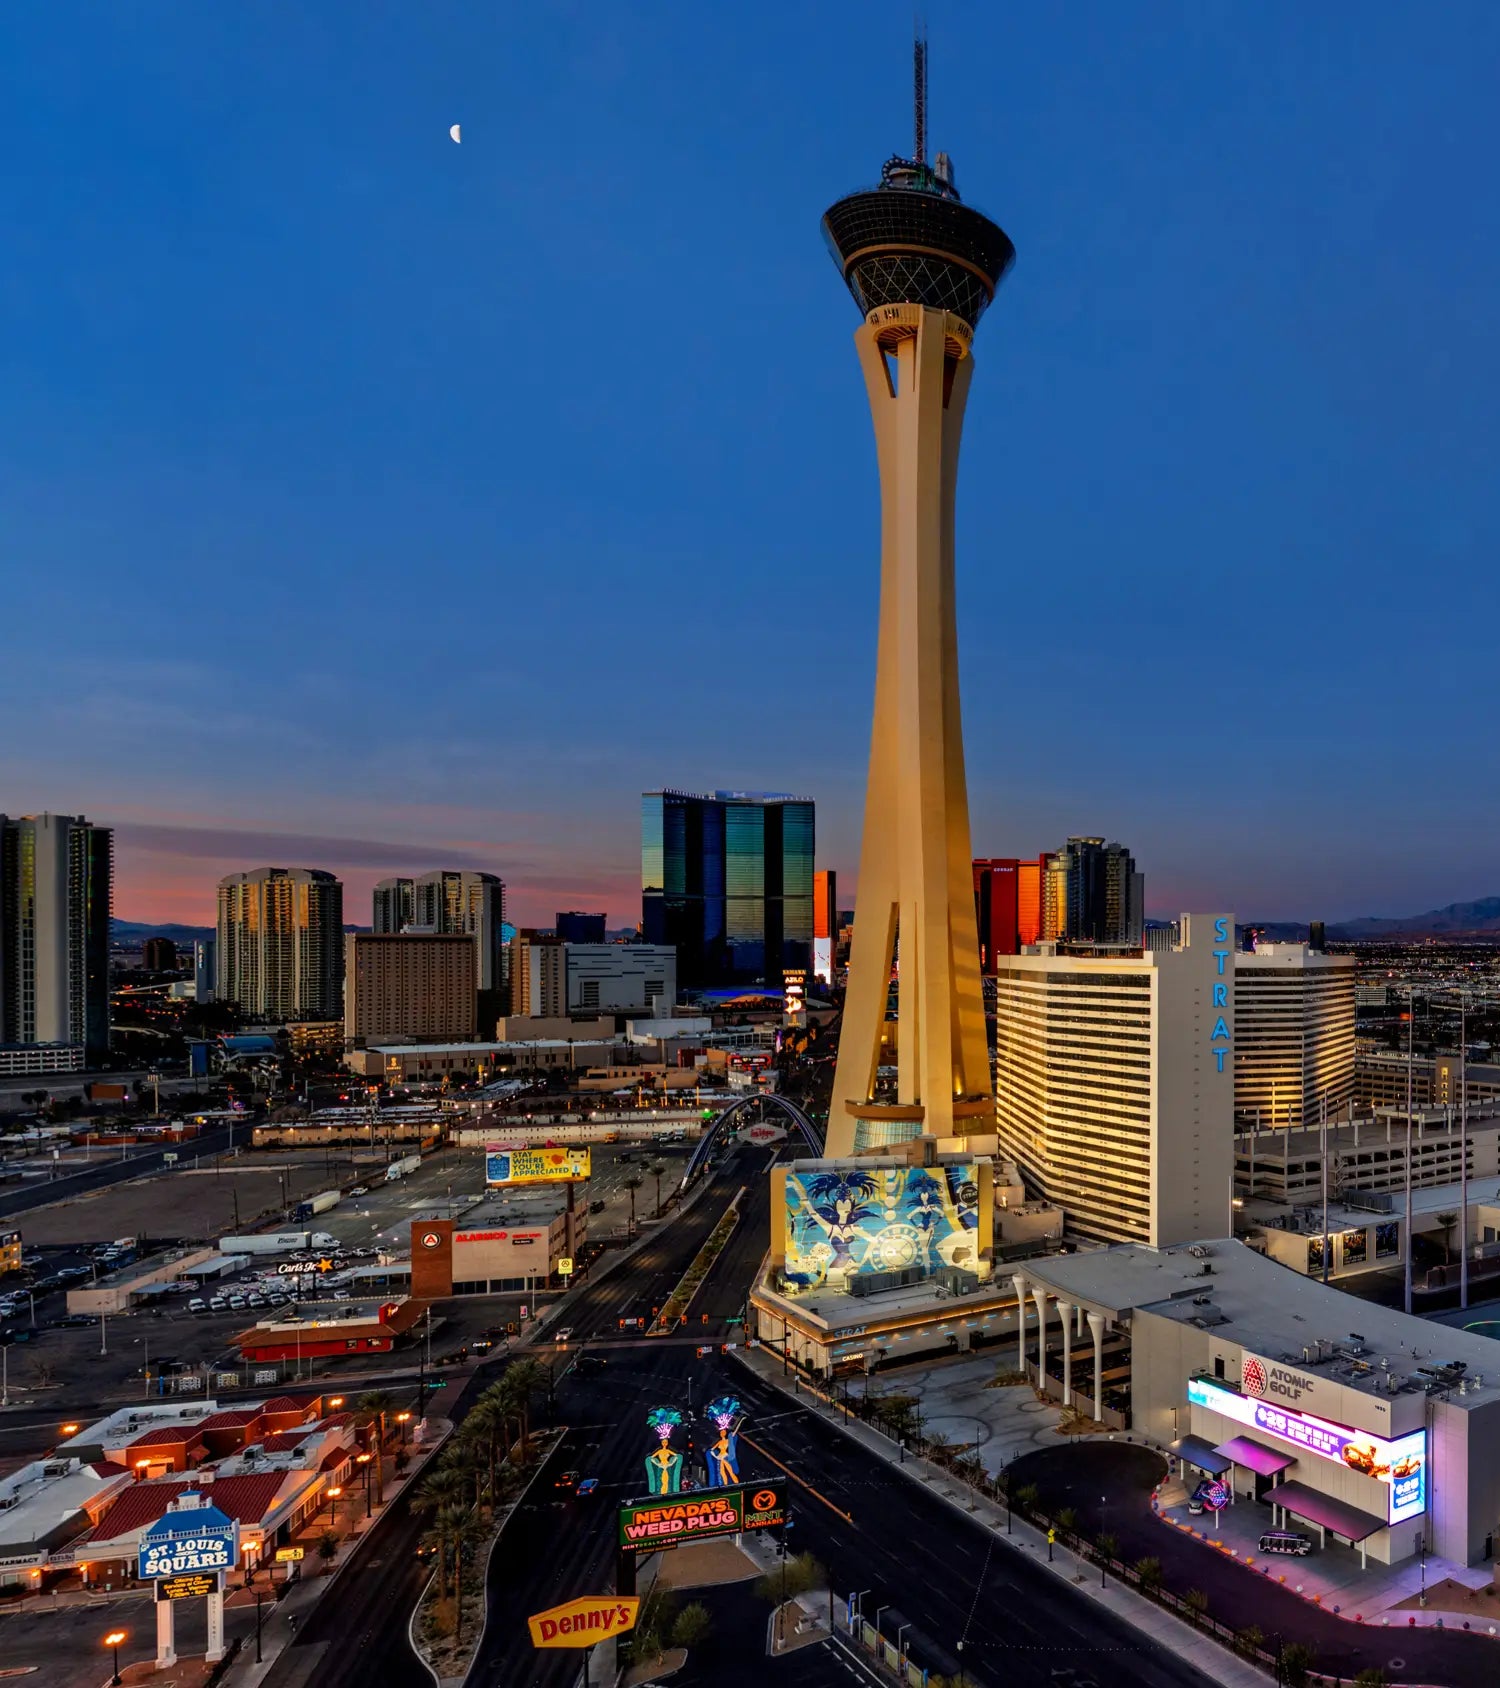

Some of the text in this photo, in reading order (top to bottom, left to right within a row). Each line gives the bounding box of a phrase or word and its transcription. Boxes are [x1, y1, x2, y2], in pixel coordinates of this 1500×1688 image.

[1211, 918, 1231, 1073] STRAT
[513, 1163, 545, 1171] YOU'RE
[513, 1167, 569, 1177] APPRECIATED
[455, 1232, 508, 1243] ALARMCO
[278, 1262, 303, 1274] Carl's
[834, 1326, 867, 1339] STRAT
[842, 1353, 864, 1362] CASINO
[1270, 1367, 1314, 1393] ATOMIC
[1270, 1379, 1302, 1400] GOLF
[635, 1500, 728, 1525] NEVADA'S
[745, 1509, 784, 1524] MINT
[627, 1520, 684, 1539] WEED
[687, 1511, 736, 1530] PLUG
[745, 1518, 784, 1529] CANNABIS
[148, 1539, 225, 1561] ST. LOUIS
[622, 1537, 678, 1550] MINTDEALS.COM
[145, 1551, 229, 1575] SQUARE
[539, 1603, 631, 1642] Denny's
